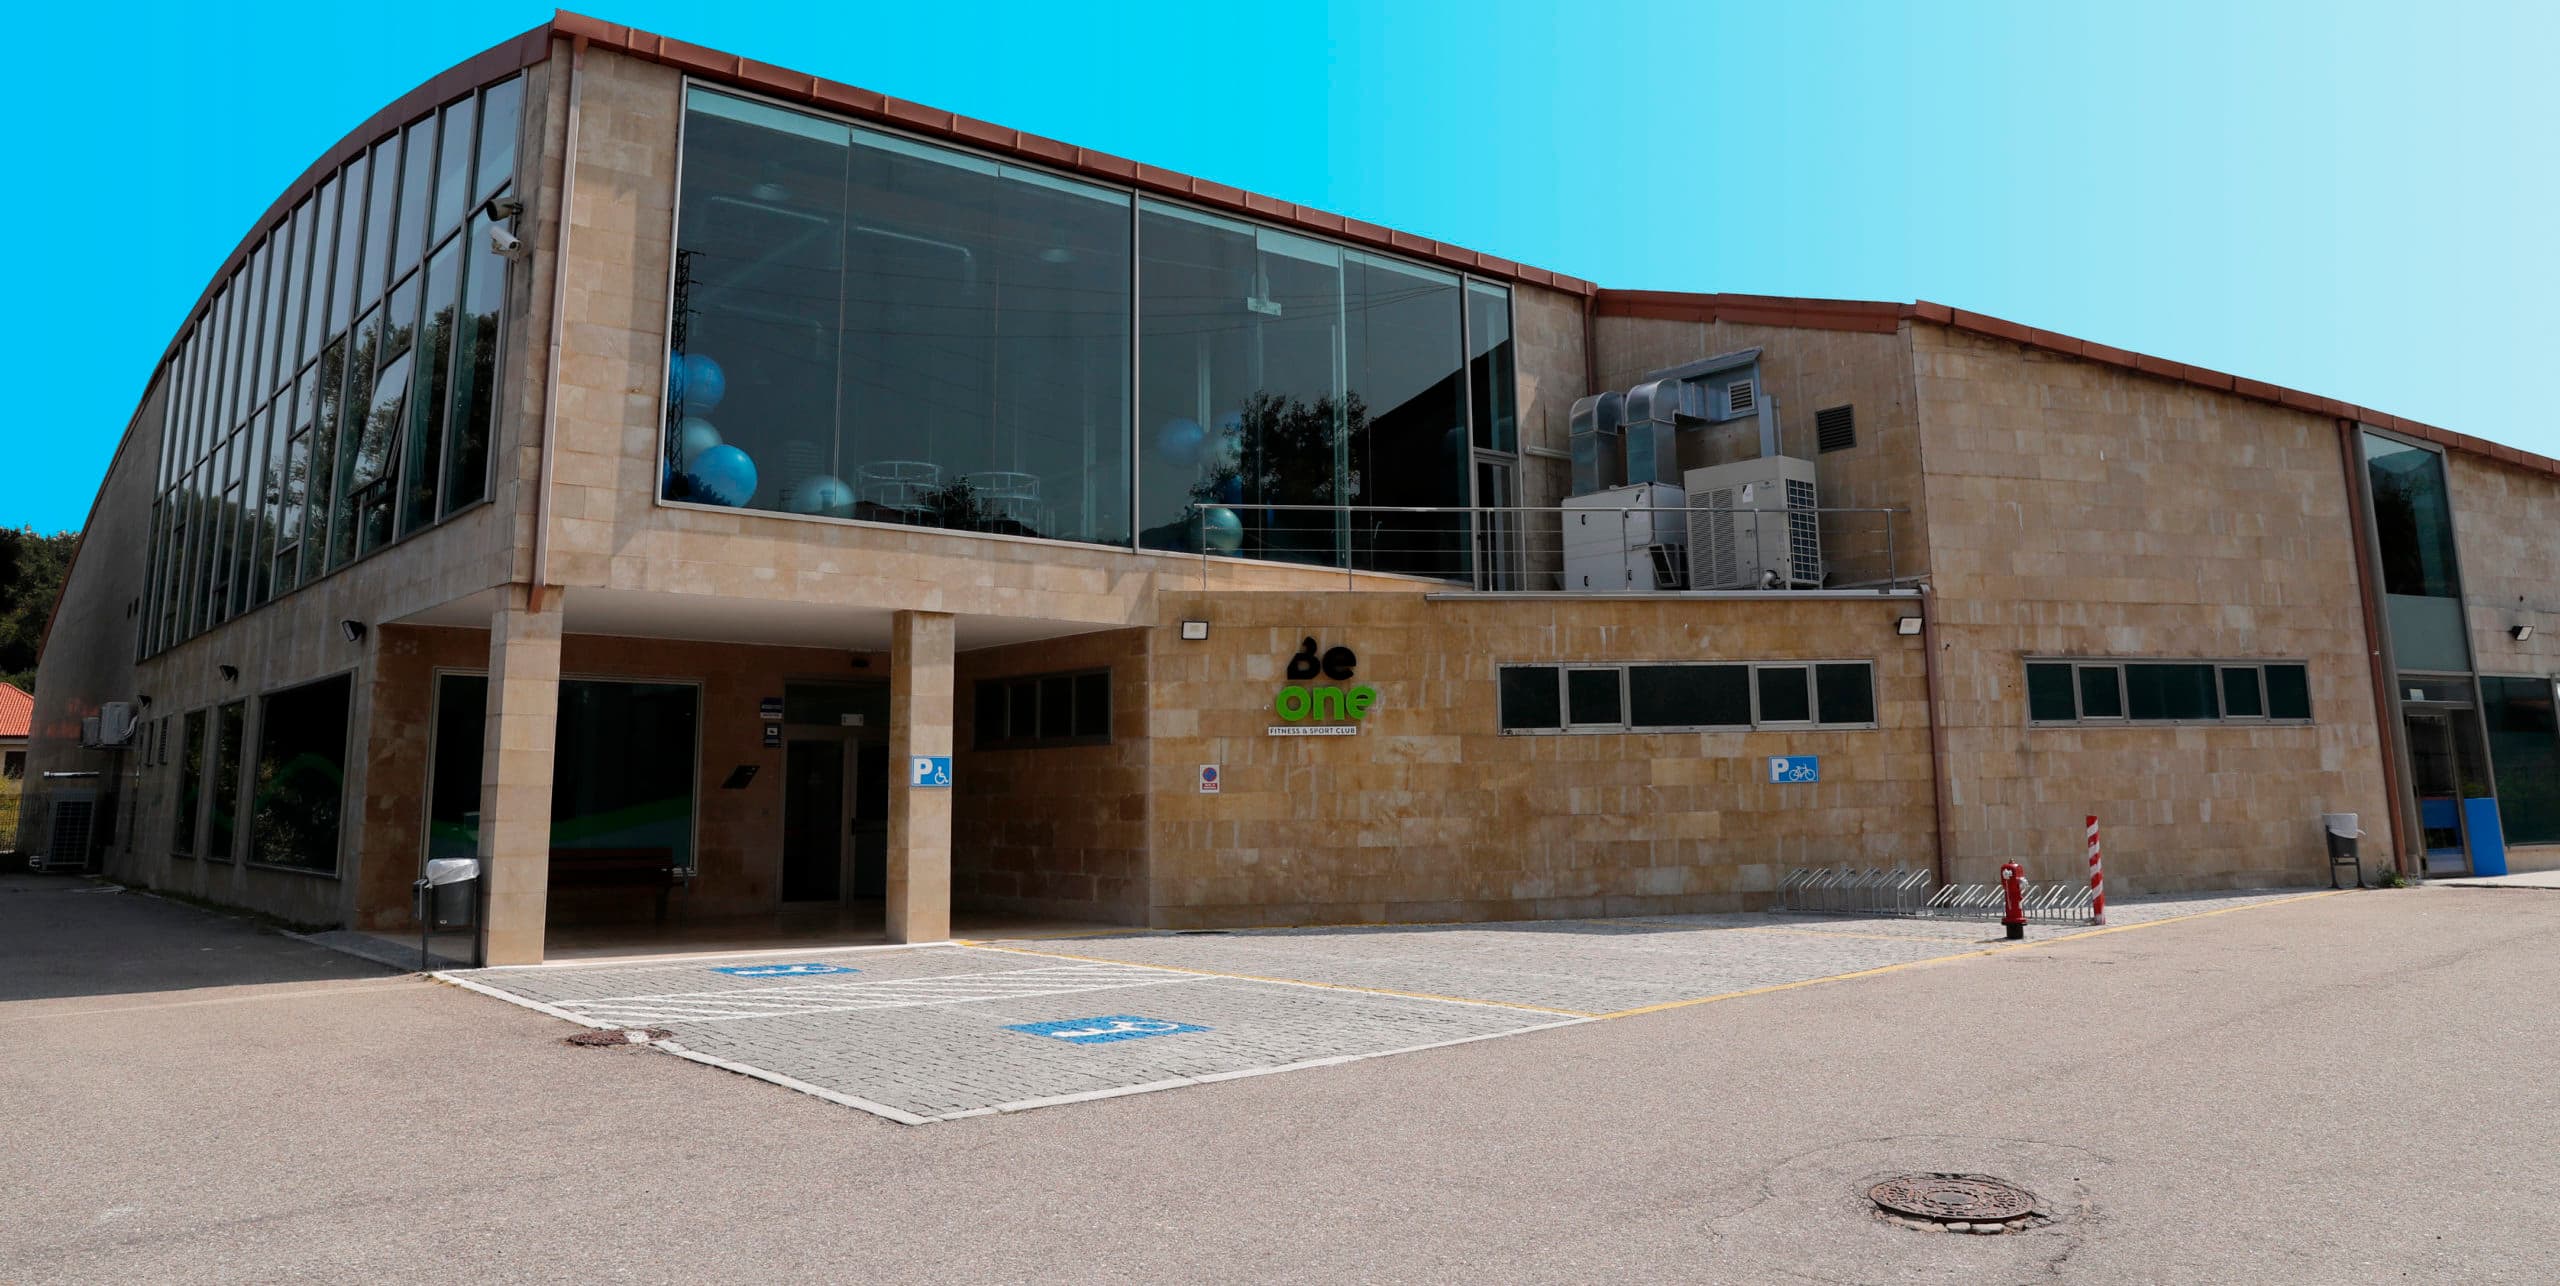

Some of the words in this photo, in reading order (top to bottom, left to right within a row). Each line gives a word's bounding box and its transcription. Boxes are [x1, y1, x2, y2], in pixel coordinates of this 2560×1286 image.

[1275, 685, 1377, 722] one
[913, 758, 933, 784] P
[1771, 758, 1789, 781] P
